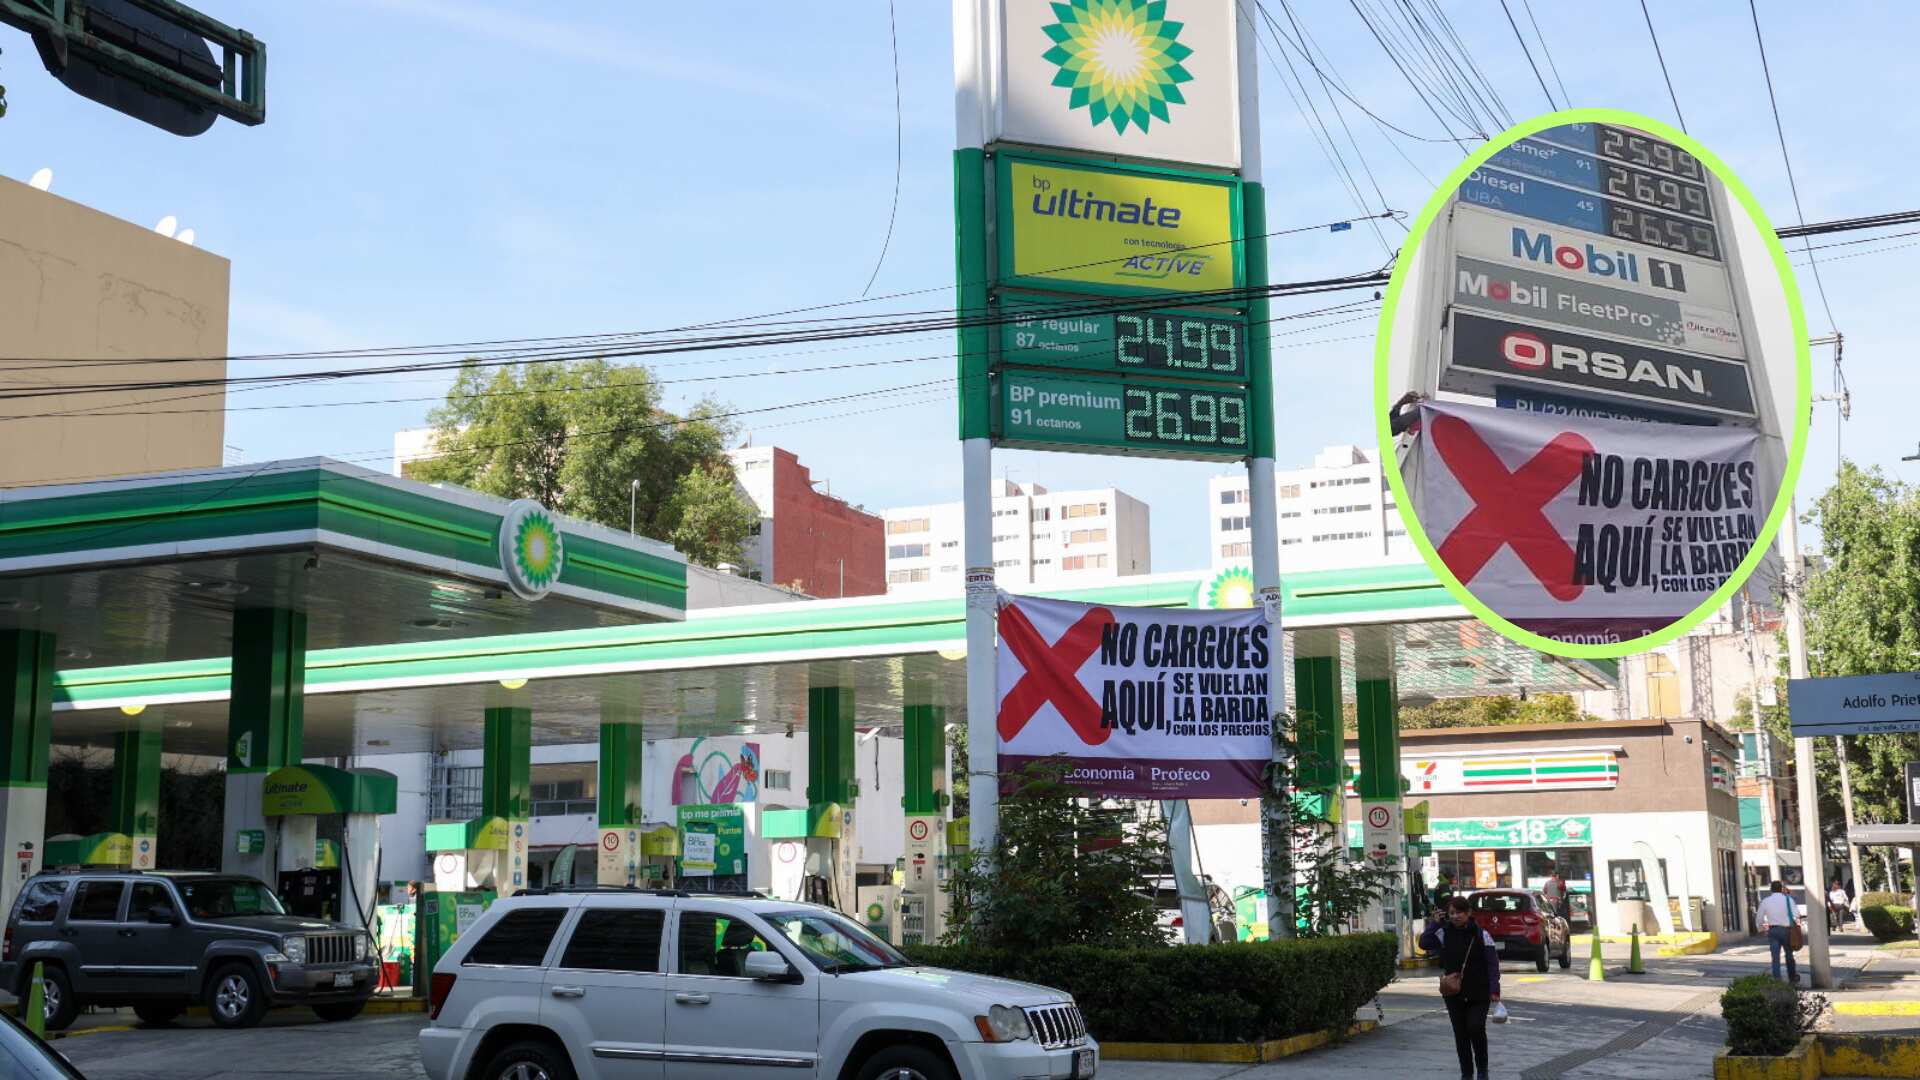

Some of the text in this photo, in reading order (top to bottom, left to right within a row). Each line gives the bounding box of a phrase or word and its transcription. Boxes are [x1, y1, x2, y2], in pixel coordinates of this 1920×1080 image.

[1576, 159, 1591, 170] 91
[1032, 175, 1051, 192] bp
[1467, 170, 1525, 195] Diesel
[1032, 188, 1182, 229] ultimate
[1576, 200, 1594, 211] 45
[1122, 255, 1205, 276] ACTIVE
[1512, 227, 1675, 290] Mobil 1
[1459, 270, 1655, 327] Mobil FleetPro
[1015, 332, 1036, 347] 87
[1041, 319, 1100, 334] regular
[1117, 314, 1237, 373] 24.99
[1503, 334, 1702, 394] ORSAN
[1009, 384, 1121, 412] BP premium
[1010, 408, 1081, 430] 91 octanos
[1126, 388, 1248, 446] 26.99
[1578, 451, 1755, 511] NO CARGUES
[1661, 513, 1757, 543] SE VUELAN
[1572, 514, 1659, 594] AQUÍ,
[1660, 541, 1753, 576] LA BARD
[1661, 578, 1688, 593] CON
[1691, 576, 1716, 593] LOS
[1100, 622, 1270, 670] NO CARGUES
[1173, 672, 1268, 696] SE VUELAN
[1100, 671, 1172, 737] AQUÍ,
[1173, 696, 1269, 724] LA BARDA
[1843, 694, 1887, 709] Adolfo
[1173, 724, 1197, 737] CON
[1198, 723, 1218, 737] LOS
[1151, 767, 1211, 782] Profeco
[1508, 819, 1548, 845] $18
